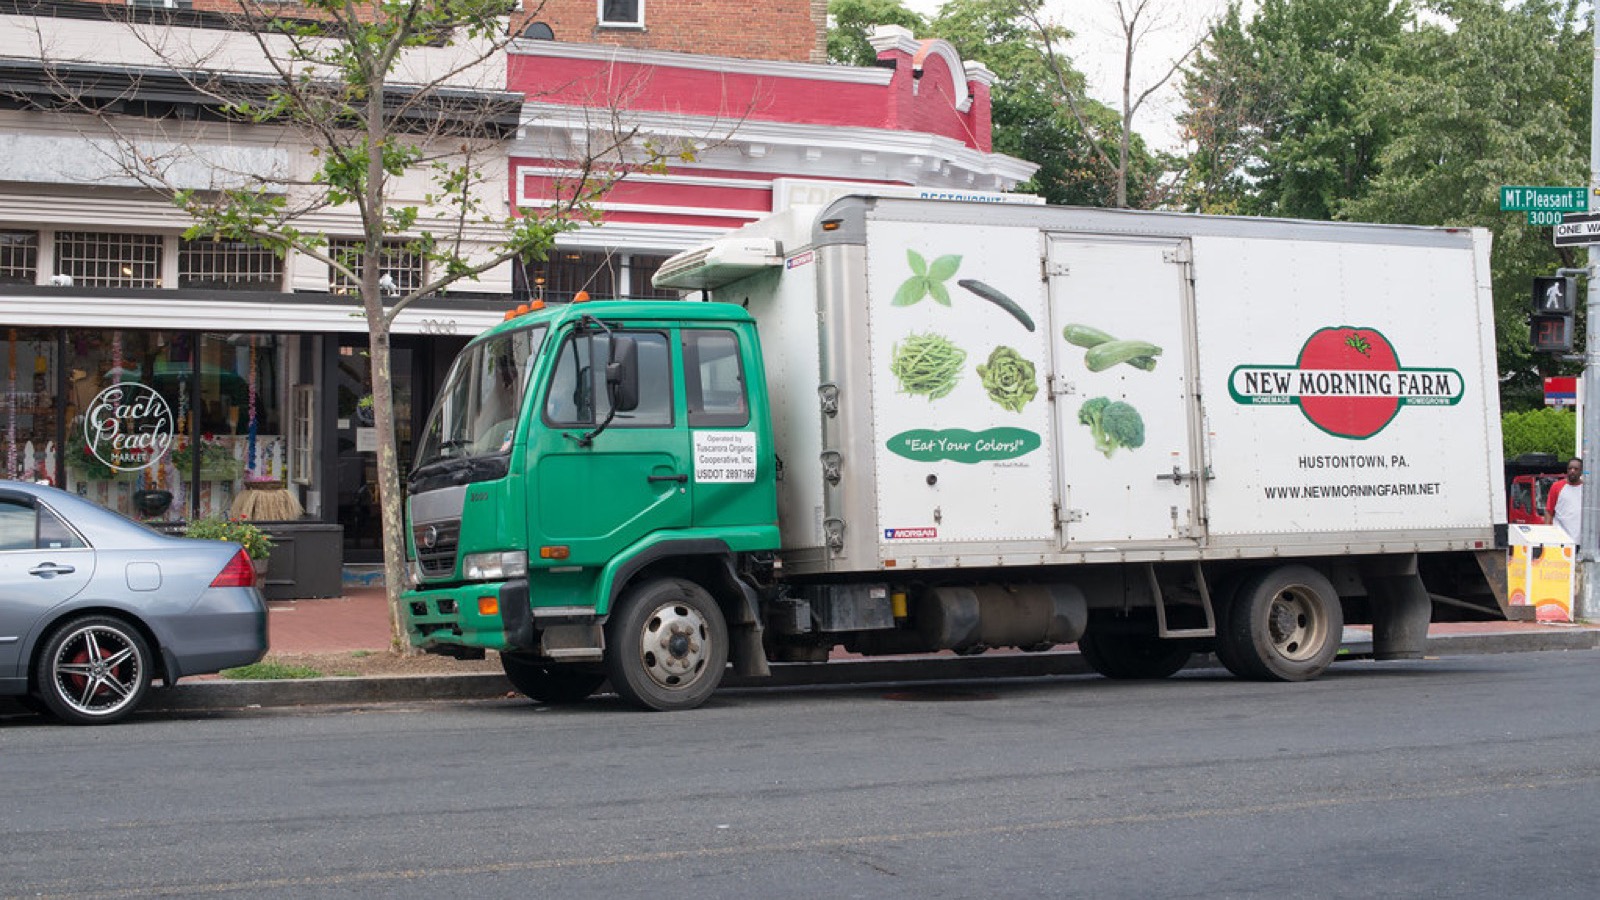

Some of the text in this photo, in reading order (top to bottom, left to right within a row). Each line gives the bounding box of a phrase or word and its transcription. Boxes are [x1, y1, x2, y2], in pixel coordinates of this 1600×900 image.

[1530, 211, 1562, 225] 3000
[1558, 223, 1600, 235] ONE WA
[419, 319, 457, 336] 3068
[1539, 321, 1564, 344] 20
[1245, 372, 1452, 395] NEW MORNING FARM
[91, 389, 168, 428] Each
[91, 418, 169, 452] Peach
[729, 443, 754, 454] Organic
[938, 438, 971, 452] Your
[111, 453, 147, 462] MARKET
[1298, 455, 1410, 469] HUSTONTOWN, PA.
[696, 469, 724, 479] USDOT
[1264, 483, 1441, 499] WWW.NEWMORNINGFARM.NET
[894, 529, 934, 538] MORGAN
